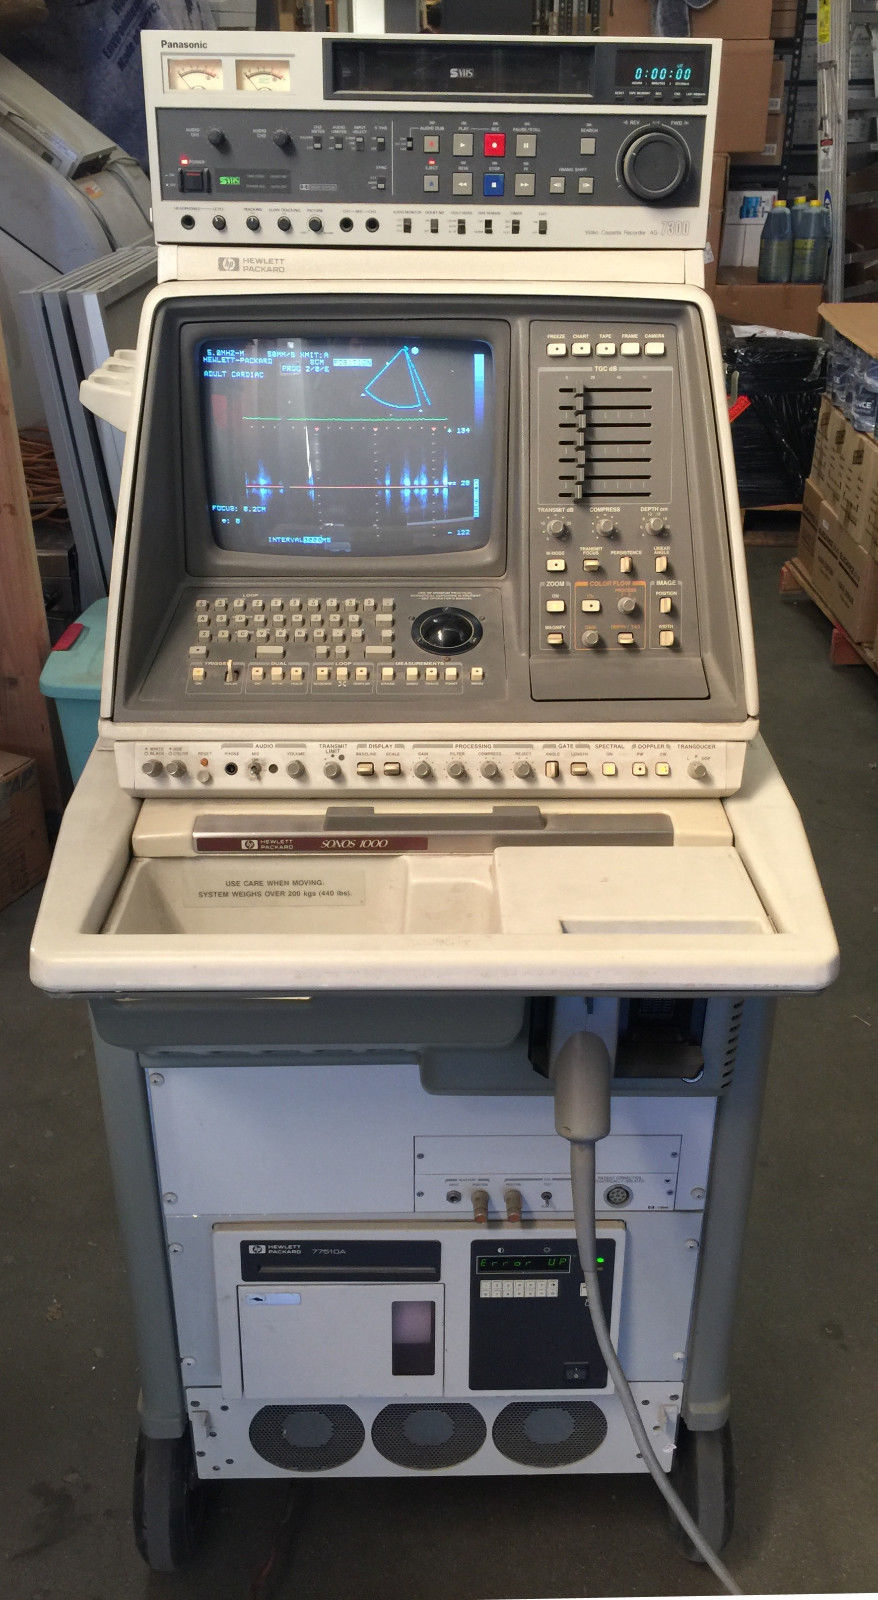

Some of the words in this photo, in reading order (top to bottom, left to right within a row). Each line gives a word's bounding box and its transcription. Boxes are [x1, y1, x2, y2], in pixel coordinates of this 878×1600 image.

[161, 39, 208, 49] Panasonic
[635, 67, 692, 80] 0:00:00
[202, 356, 273, 365] HEWLETT-PACKARD
[203, 370, 227, 378] ADULT
[320, 839, 356, 849] SONOS
[359, 839, 389, 848] 1000
[303, 890, 317, 898] kgs
[480, 1258, 532, 1268] Error
